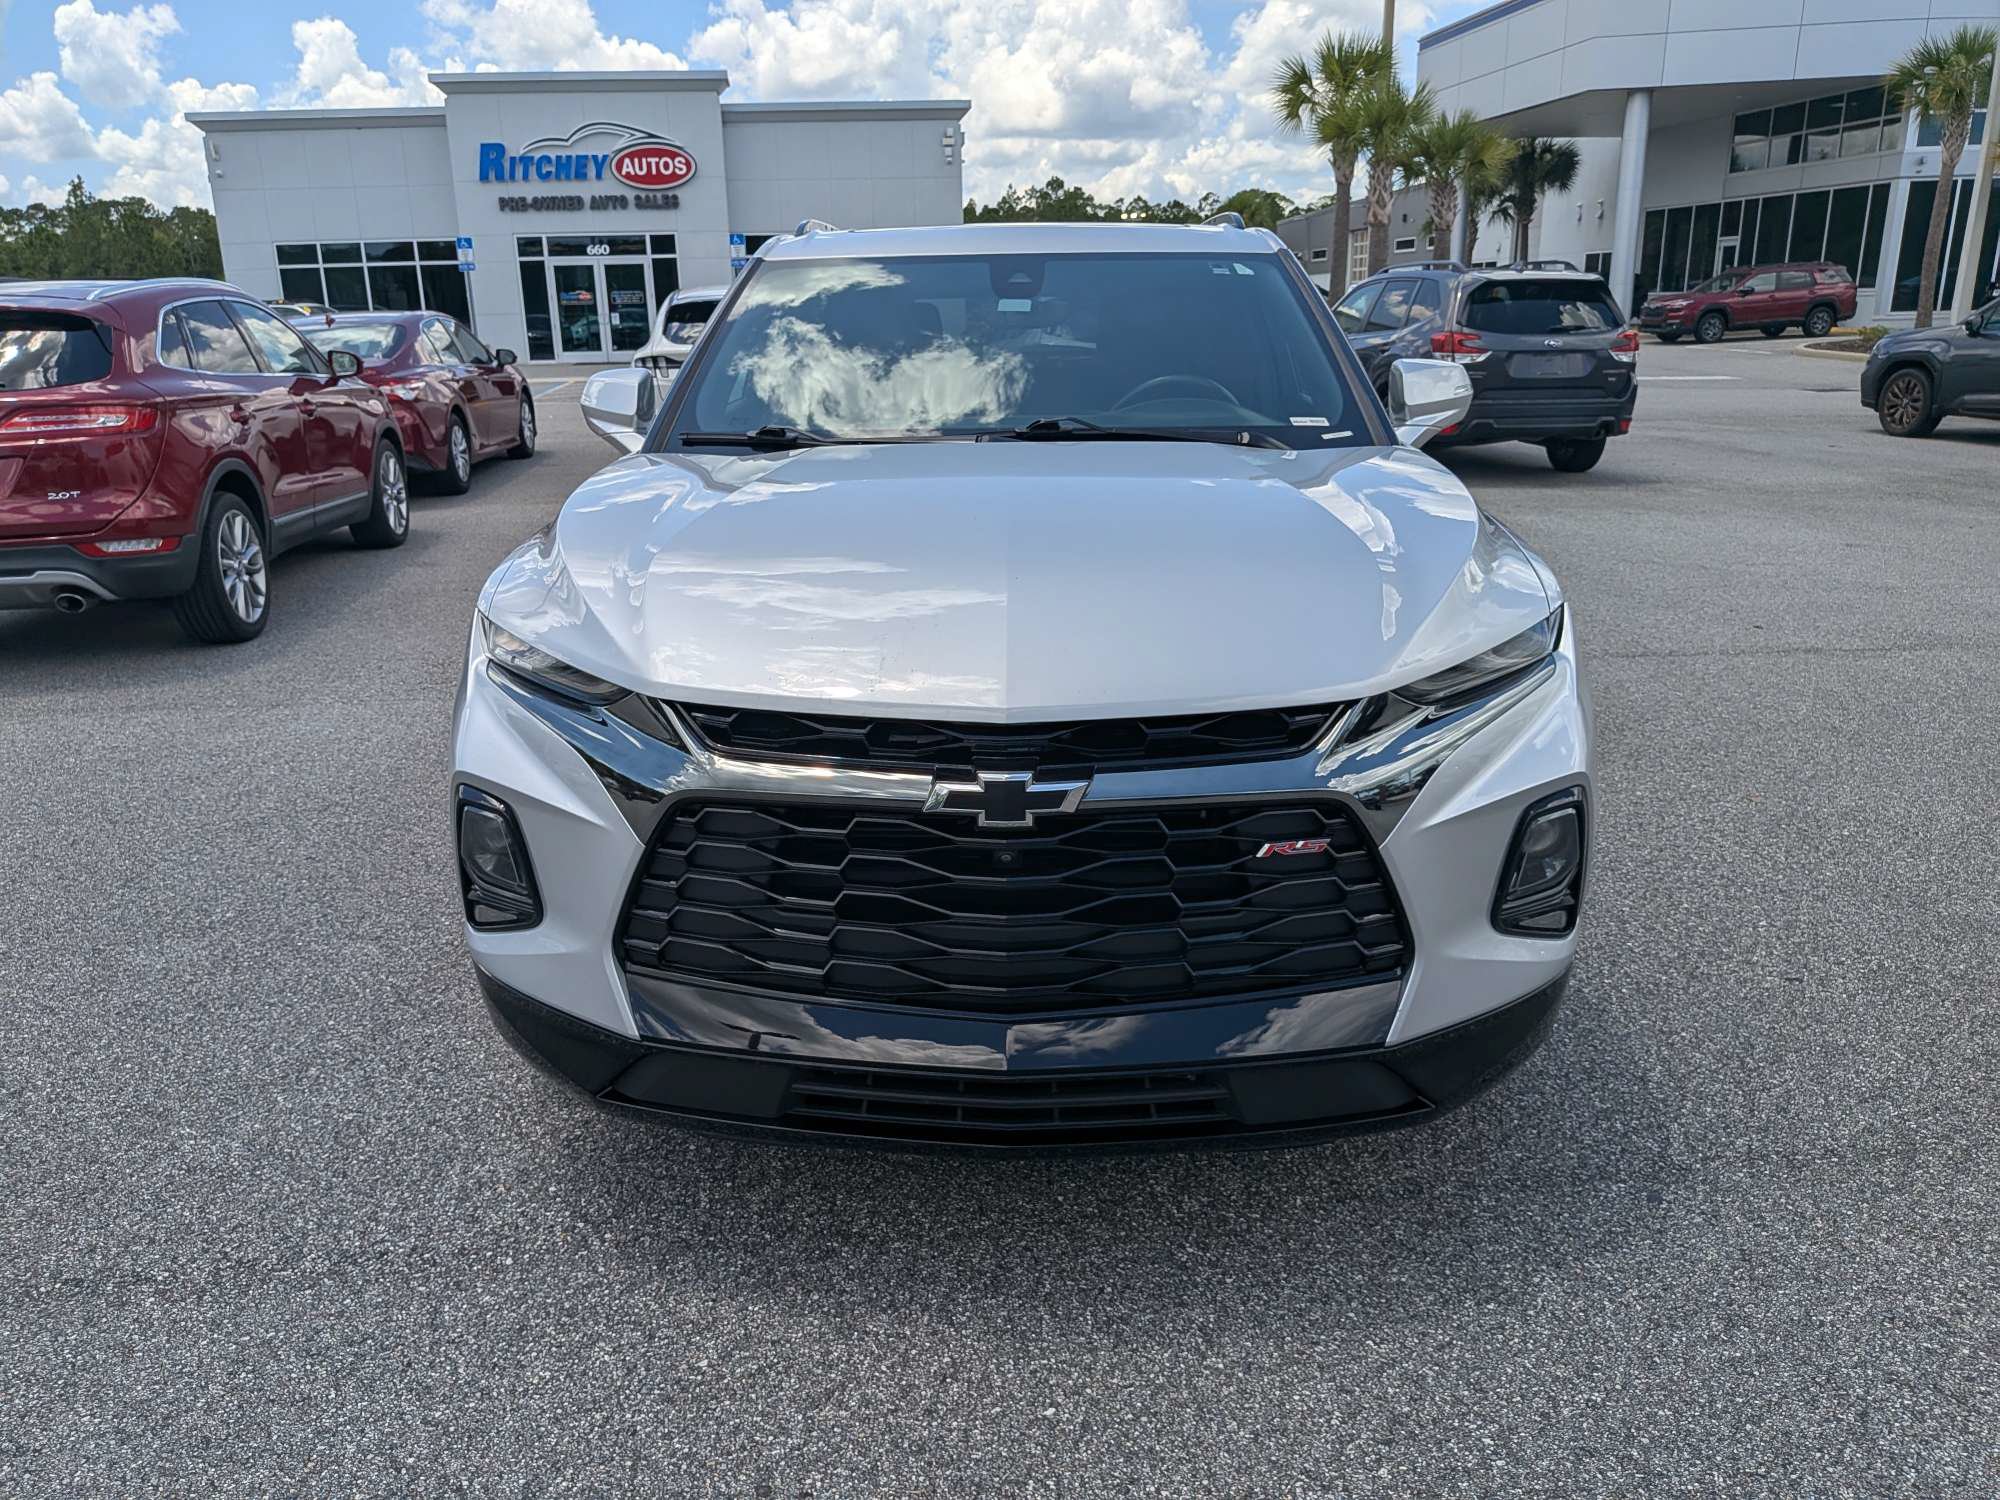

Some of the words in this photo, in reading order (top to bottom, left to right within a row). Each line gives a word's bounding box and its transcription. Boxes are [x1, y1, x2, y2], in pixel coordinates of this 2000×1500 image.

[480, 143, 609, 182] RITCHEY
[621, 157, 688, 176] AUTOS
[498, 196, 585, 212] PRE-OWNED
[590, 195, 629, 210] AUTO
[634, 194, 680, 210] SALES
[586, 244, 610, 256] 660
[1256, 839, 1331, 857] RS
